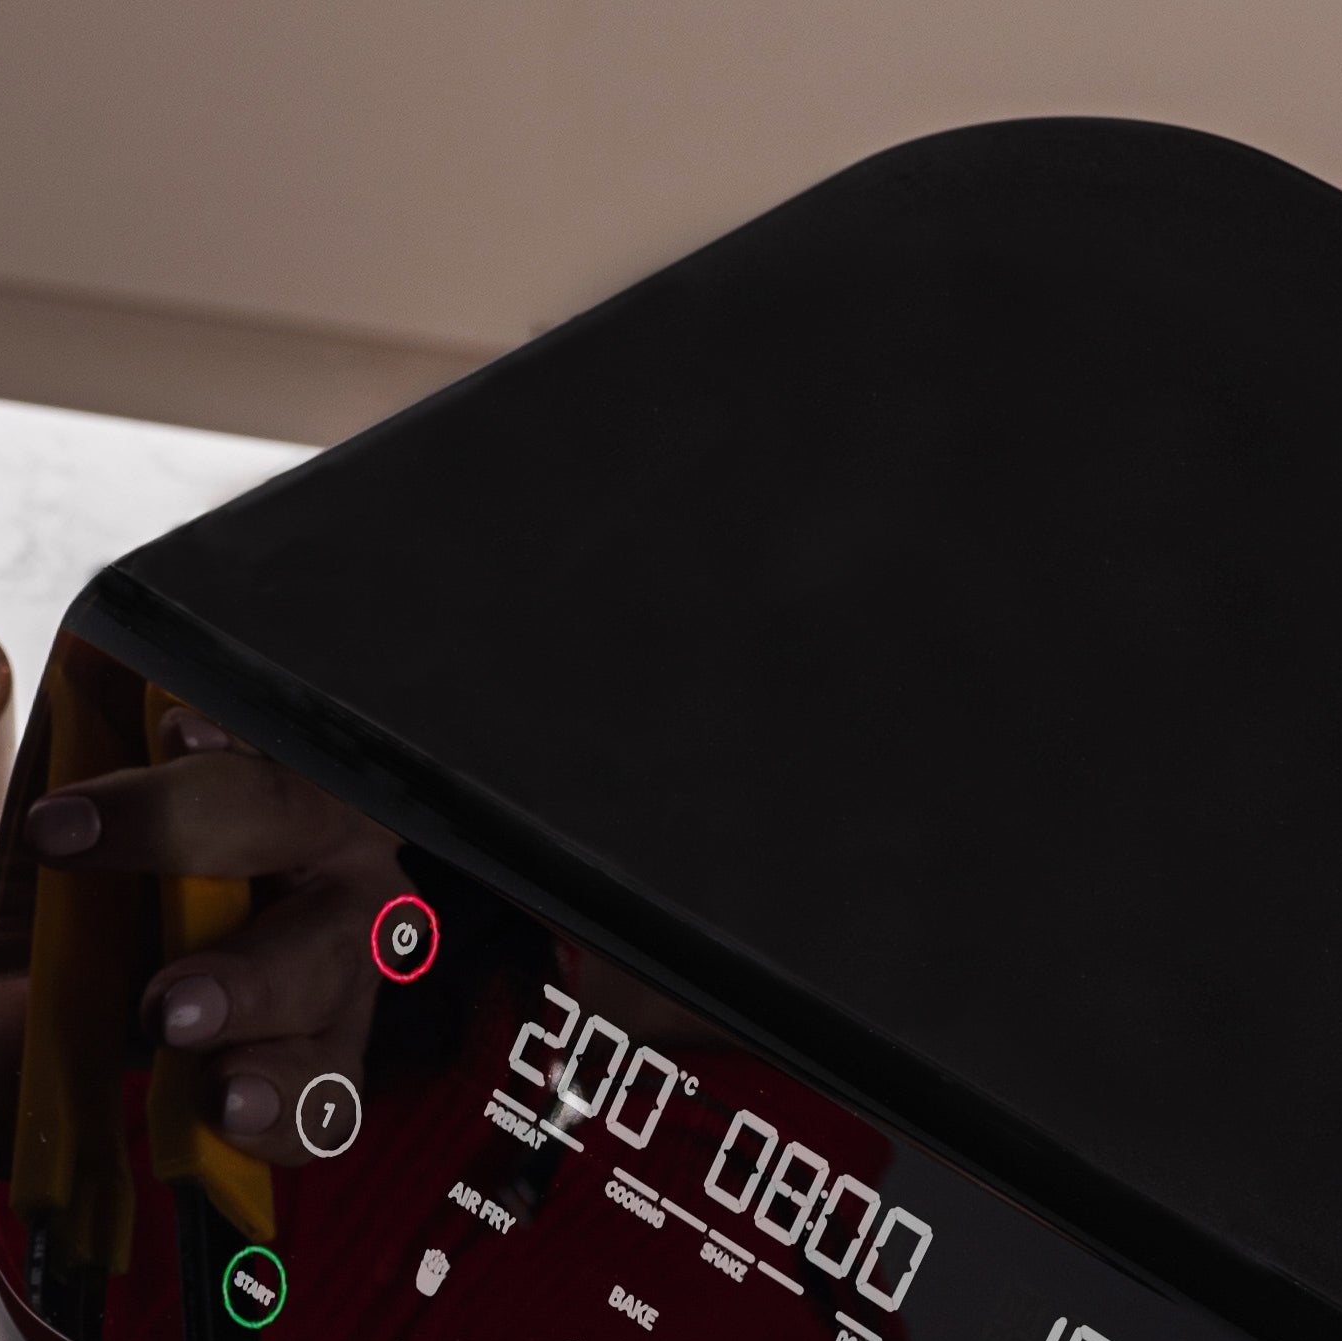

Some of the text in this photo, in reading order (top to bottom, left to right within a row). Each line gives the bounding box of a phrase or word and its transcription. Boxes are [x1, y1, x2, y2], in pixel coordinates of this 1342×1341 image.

[322, 1102, 336, 1129] 1
[447, 1181, 517, 1235] AIR FRY
[483, 1100, 548, 1150] PREHEAT
[604, 1180, 666, 1229] COOKING
[699, 1242, 748, 1283] SHAKE
[233, 1270, 276, 1306] START
[608, 1285, 660, 1331] BAKE
